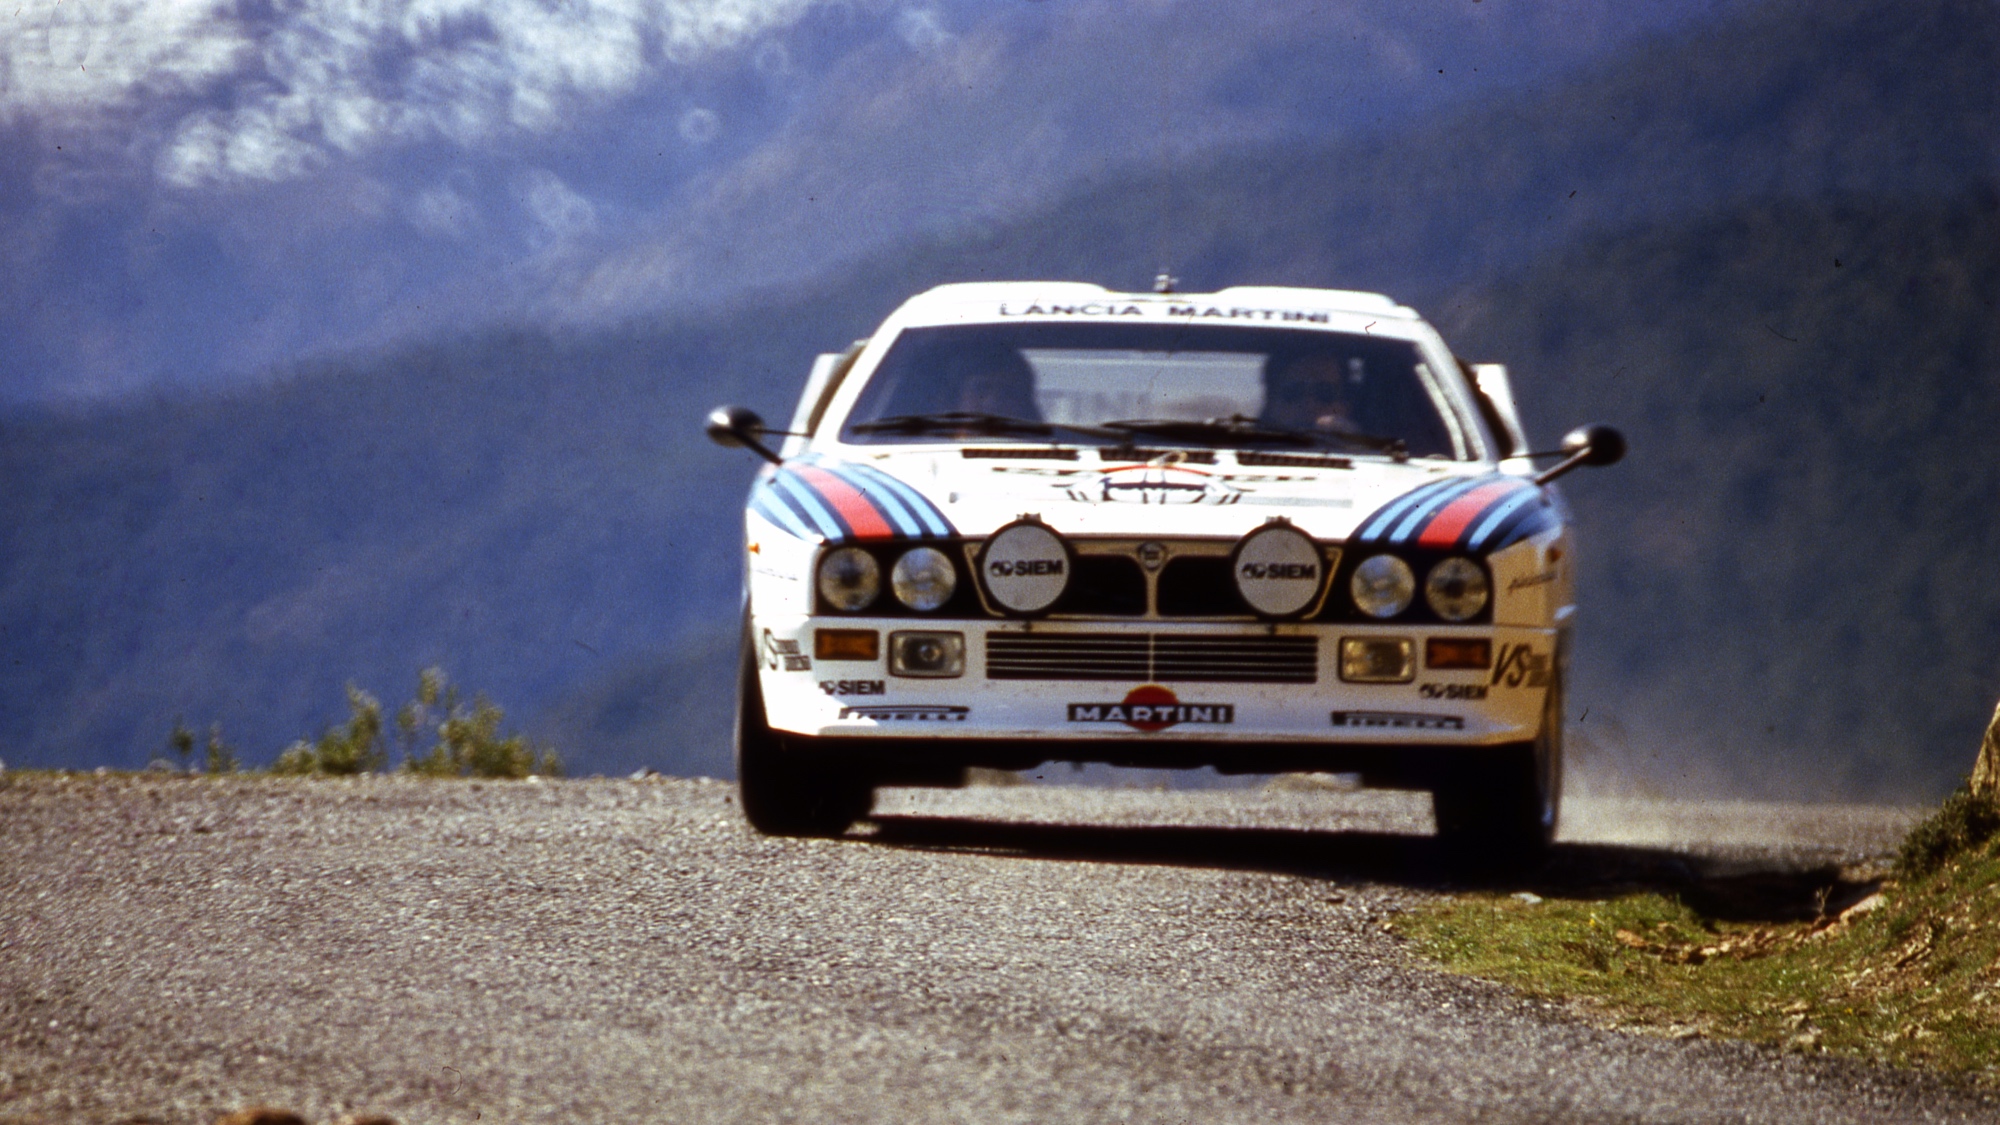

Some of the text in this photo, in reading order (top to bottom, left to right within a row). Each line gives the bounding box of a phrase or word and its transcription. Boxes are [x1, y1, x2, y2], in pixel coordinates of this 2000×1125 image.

[1000, 303, 1330, 324] LANCIA MARTINI
[1015, 559, 1064, 576] SIEM
[1267, 563, 1316, 579] SIEM
[838, 680, 885, 695] SIEM
[1446, 683, 1488, 699] SIEM
[1074, 705, 1227, 722] MARTINI
